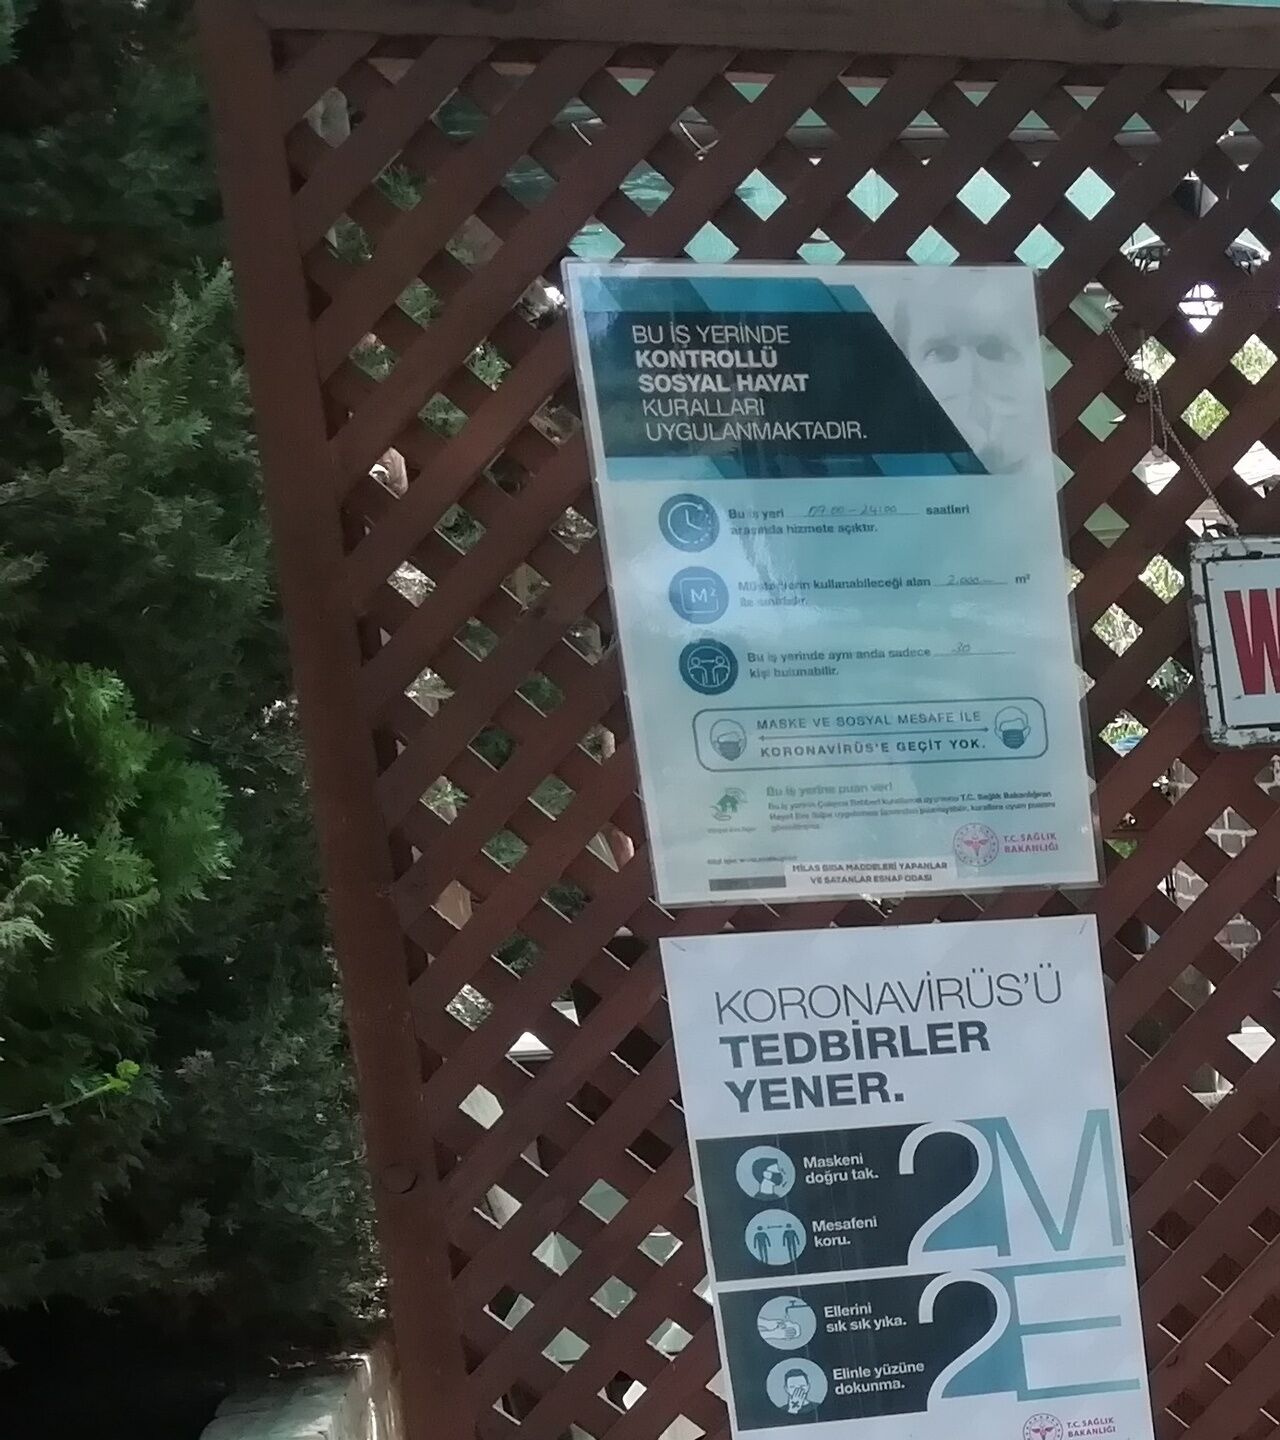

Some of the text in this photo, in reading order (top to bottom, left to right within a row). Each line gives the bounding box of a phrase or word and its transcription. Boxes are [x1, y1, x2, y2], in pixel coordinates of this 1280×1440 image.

[632, 322, 790, 348] BU İŞ YERİNDE
[636, 346, 778, 368] KONTROLLÜ
[639, 374, 809, 392] SOSYAL HAYAT
[643, 398, 765, 416] KURALLARI
[646, 421, 868, 441] UYGULANMAKTADIR.
[729, 509, 745, 519] Bu
[762, 508, 784, 521] yeri
[926, 504, 970, 515] saatleri
[814, 578, 902, 590] kullanabileceği
[906, 577, 931, 588] alan
[757, 709, 981, 730] MASKE VE SOSYAL MESAFE İLE
[896, 739, 942, 754] GEÇİT
[951, 738, 986, 750] YOK.
[715, 963, 1062, 1025] KORONAVİRÜS'Ü
[719, 1019, 990, 1069] TEDBİRLER
[724, 1071, 905, 1113] YENER.
[803, 1153, 863, 1169] Maskeni
[805, 1168, 879, 1185] doğru tak.
[812, 1216, 877, 1232] Mesafeni
[814, 1235, 851, 1248] koru.
[824, 1302, 872, 1318] Ellerini
[826, 1316, 907, 1333] sık sık yıka.
[833, 1362, 925, 1380] Elinle yüzüne
[835, 1380, 905, 1395] dokunma.
[1083, 1416, 1114, 1427] SAĞLIK
[1068, 1425, 1116, 1438] BAKANLIĞI
